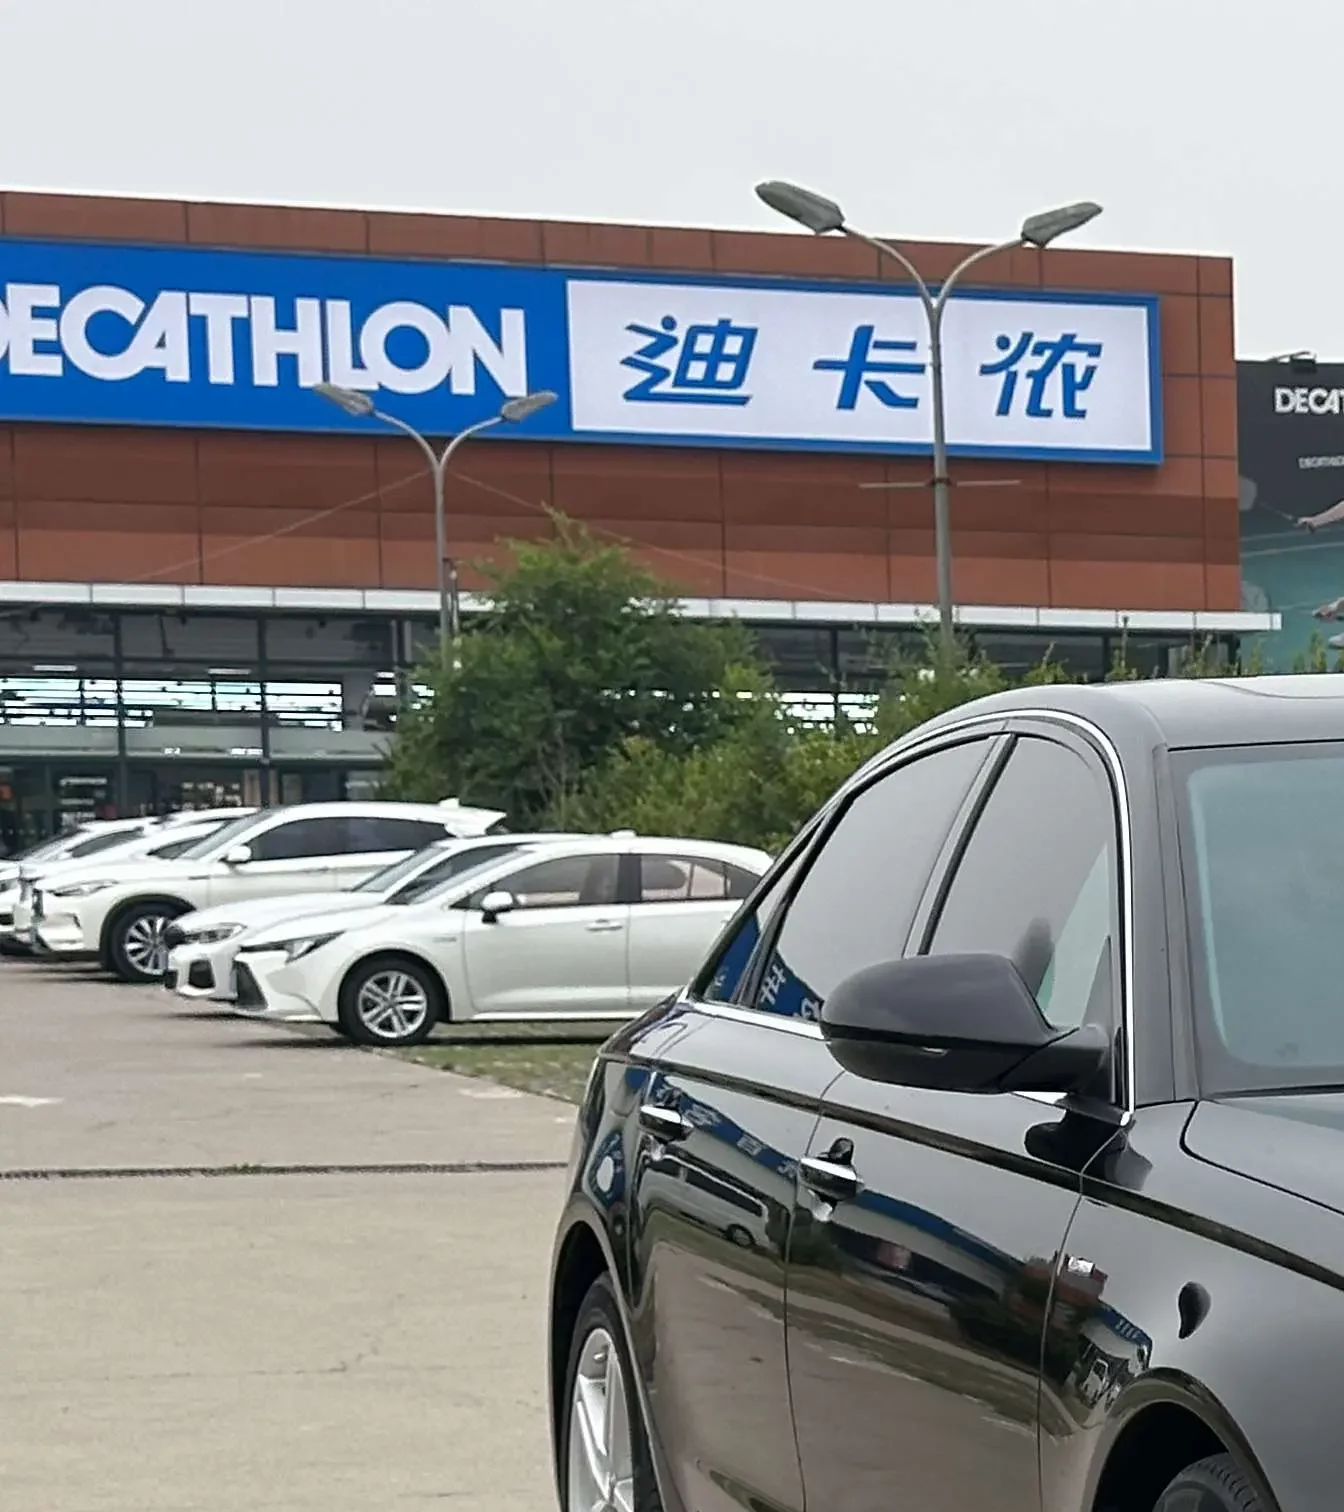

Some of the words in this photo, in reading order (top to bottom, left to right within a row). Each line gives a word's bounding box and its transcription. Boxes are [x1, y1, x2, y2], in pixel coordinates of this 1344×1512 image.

[0, 282, 528, 398] ECATHLON
[620, 315, 1102, 418] 迪卡侬
